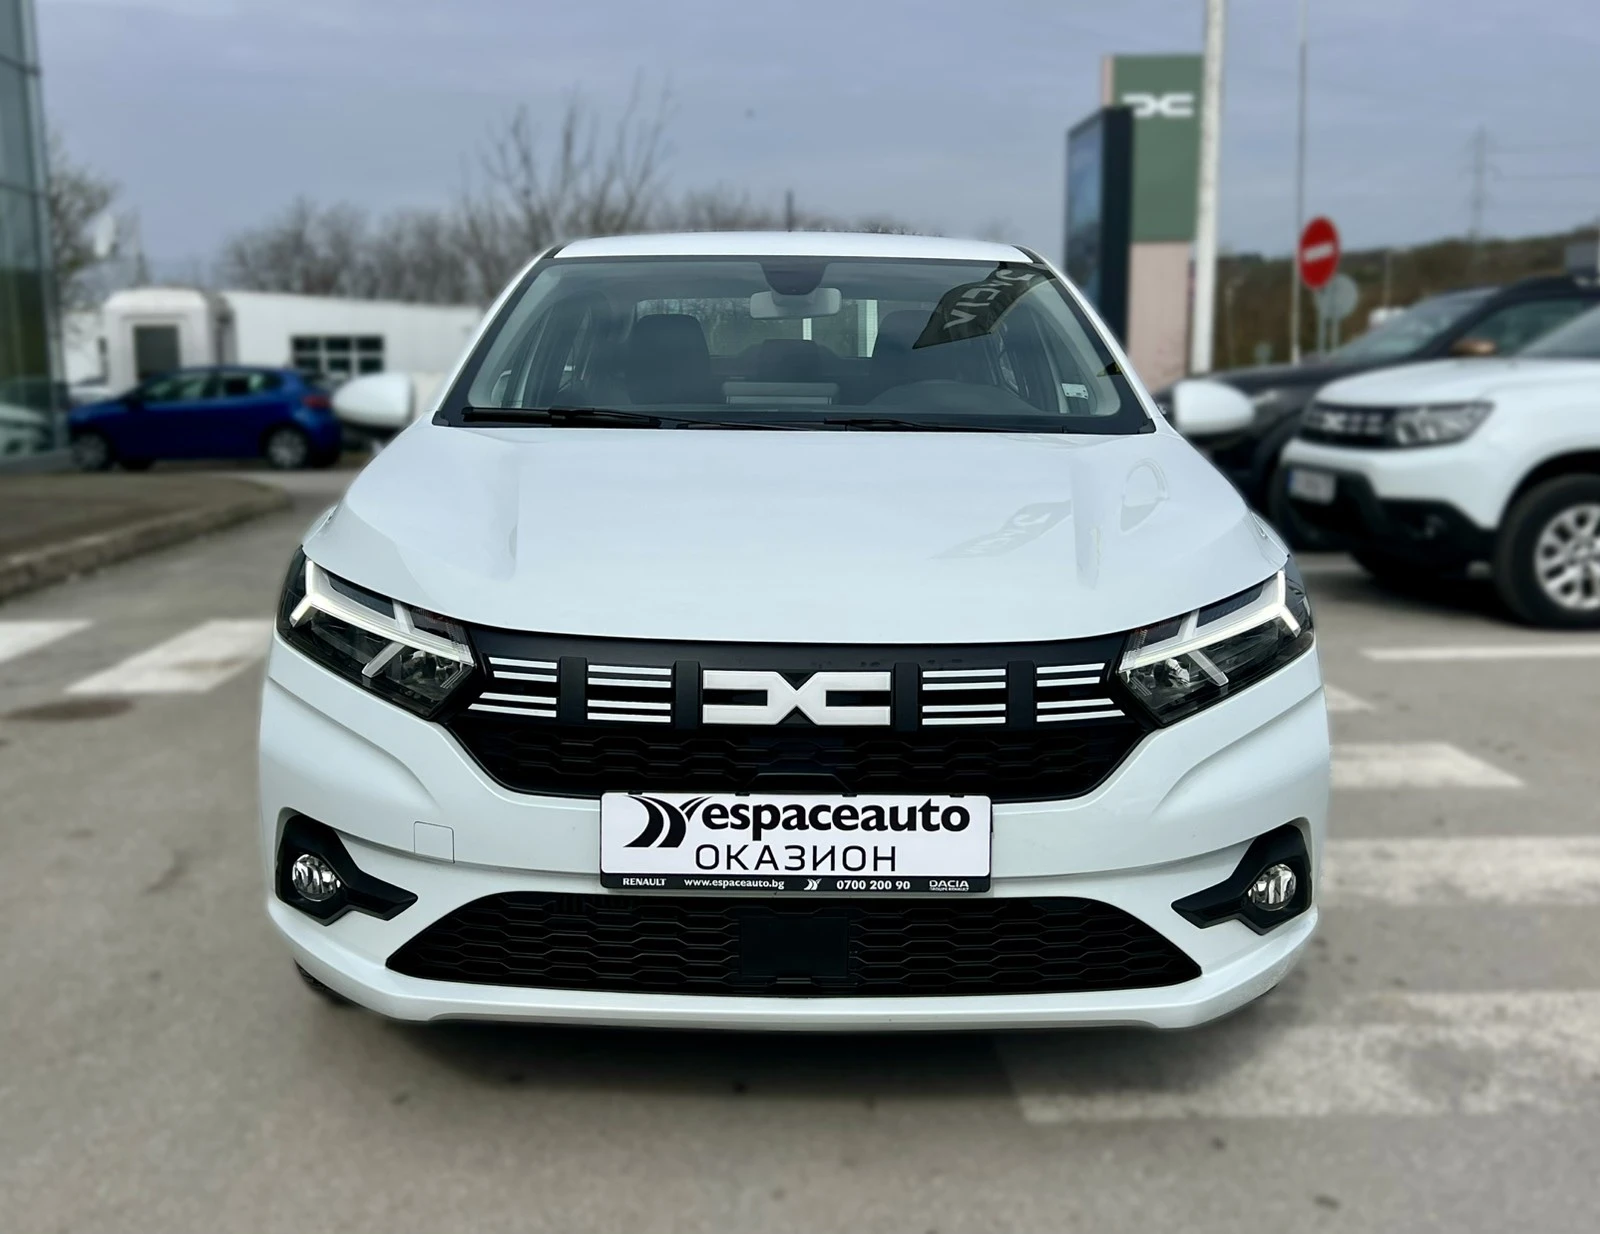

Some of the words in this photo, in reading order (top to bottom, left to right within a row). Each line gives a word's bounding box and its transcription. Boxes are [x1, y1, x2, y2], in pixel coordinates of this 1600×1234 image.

[701, 797, 971, 841] espaceauto
[695, 844, 896, 872] ОКАЗИОН
[622, 877, 667, 887] RENAULT
[683, 878, 785, 891] www.espaceauto.bg
[836, 880, 867, 891] 0700
[869, 880, 893, 891] 200
[895, 880, 911, 891] 90
[929, 879, 969, 888] DACIA
